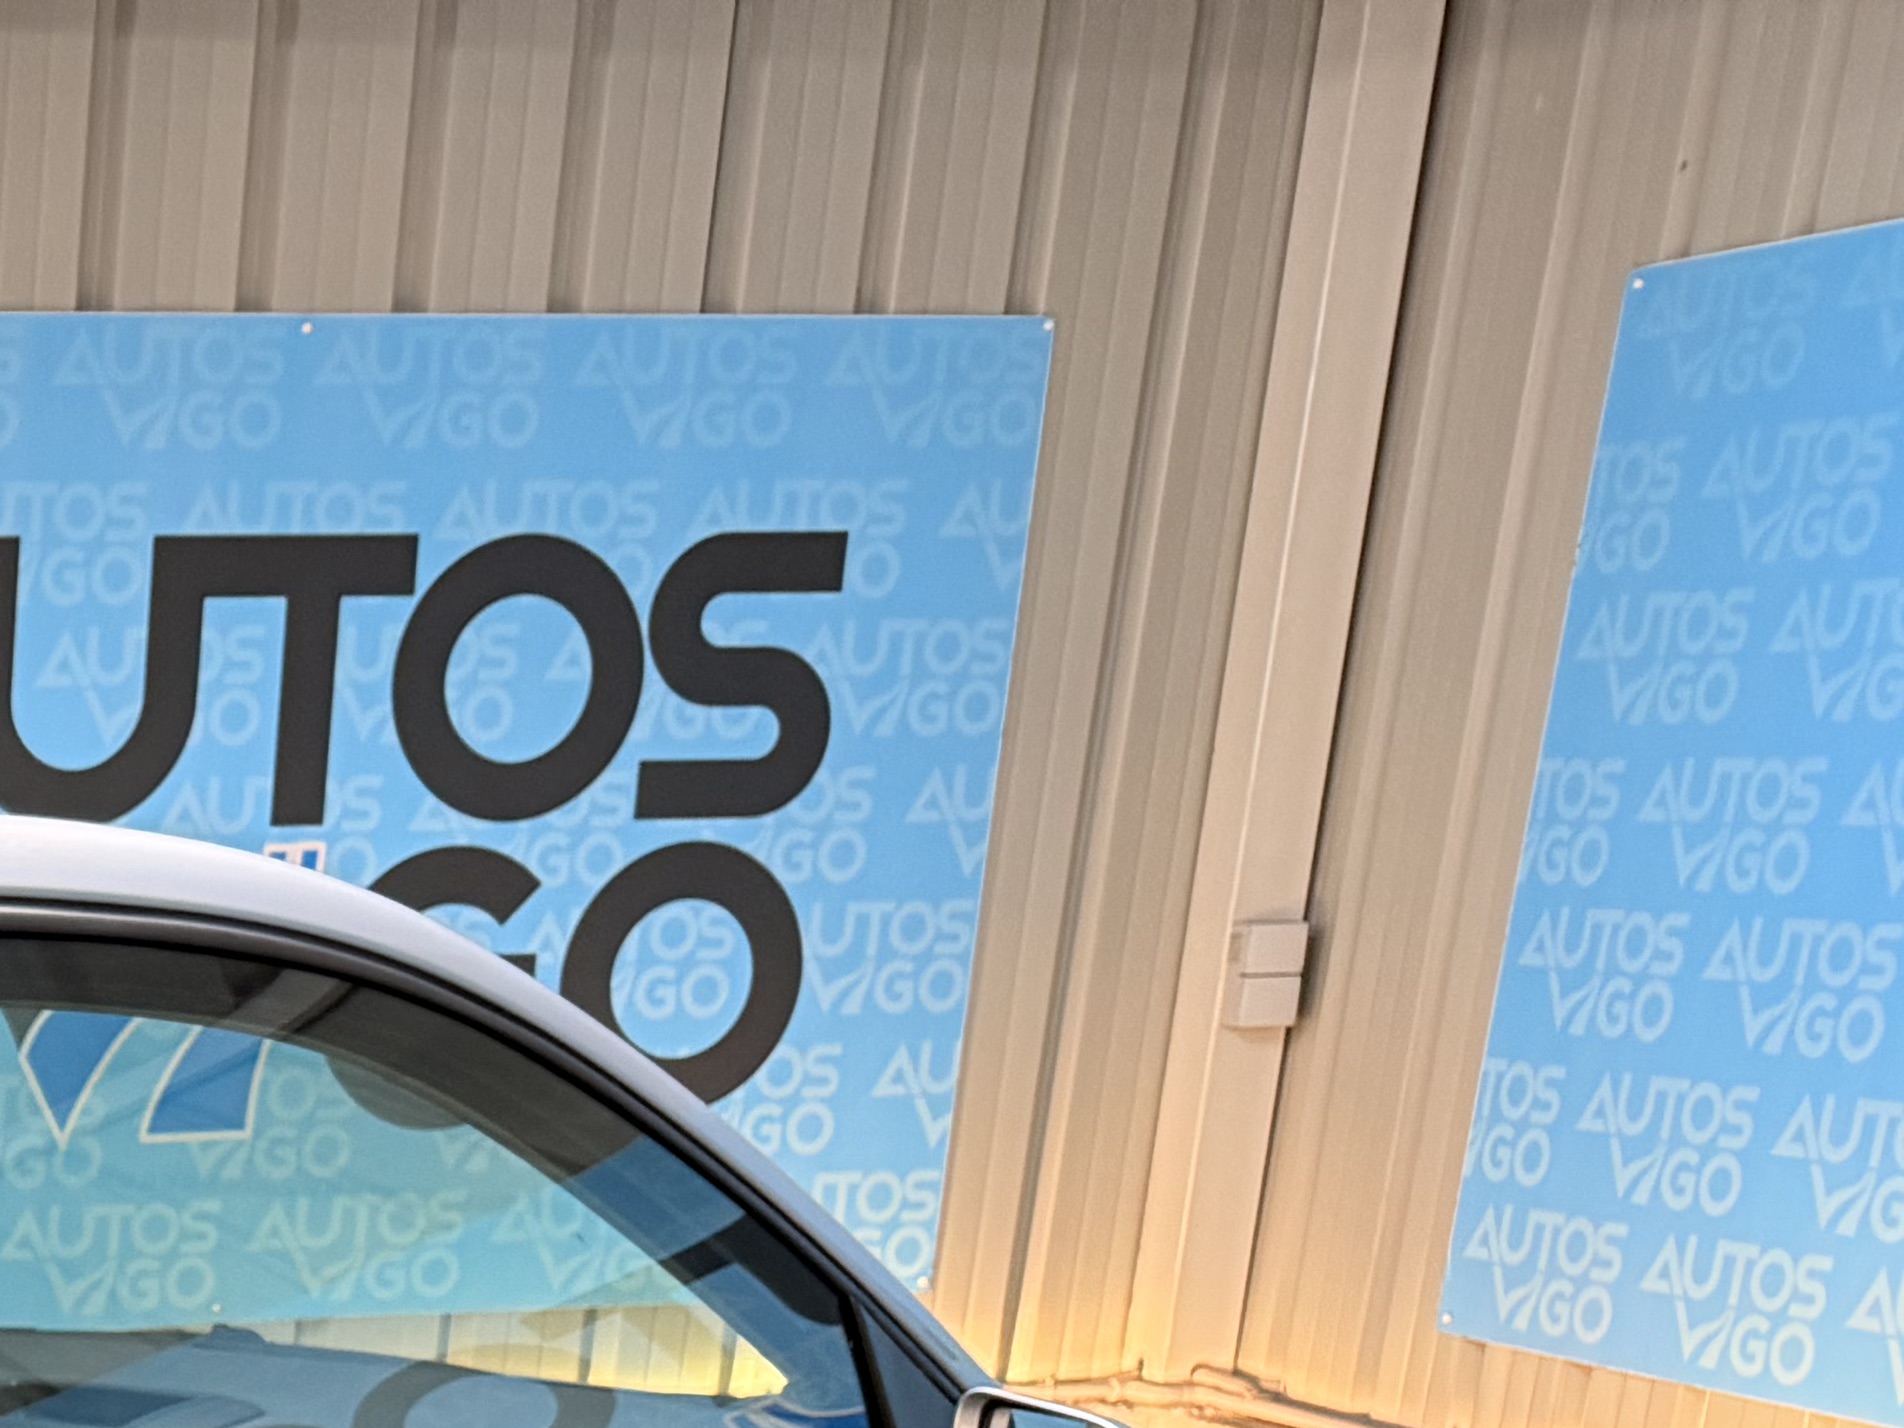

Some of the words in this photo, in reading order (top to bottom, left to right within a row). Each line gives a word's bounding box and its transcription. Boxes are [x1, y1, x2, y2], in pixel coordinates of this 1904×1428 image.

[1639, 257, 1816, 336] AUTOS
[54, 326, 284, 384] AUTOS
[315, 325, 544, 385] AUTOS
[575, 326, 797, 385] AUTOS
[827, 328, 1040, 385] AUTOS
[102, 392, 280, 449] VIGO
[361, 390, 538, 447] VIGO
[620, 390, 789, 448] VIGO
[870, 390, 1034, 448] VIGO
[1704, 412, 1898, 495] AUTOS
[1741, 489, 1878, 561] VIGO
[1577, 589, 1753, 658] AUTOS
[842, 680, 997, 736] VIGO
[1609, 659, 1735, 724] VIGO
[1638, 758, 1825, 823] AUTOS
[1674, 824, 1808, 894] VIGO
[1521, 908, 1687, 973] AUTOS
[1706, 918, 1904, 990] AUTOS
[1552, 974, 1671, 1040] VIGO
[1742, 987, 1882, 1061] VIGO
[1579, 1074, 1758, 1147] AUTOS
[1612, 1139, 1739, 1215] VIGO
[4, 1202, 218, 1259] AUTOS
[250, 1192, 465, 1250] AUTOS
[1466, 1206, 1625, 1283] AUTOS
[47, 1258, 213, 1314] VIGO
[1496, 1264, 1609, 1342] VIGO
[1643, 1236, 1831, 1319] AUTOS
[1677, 1292, 1812, 1384] VIGO
